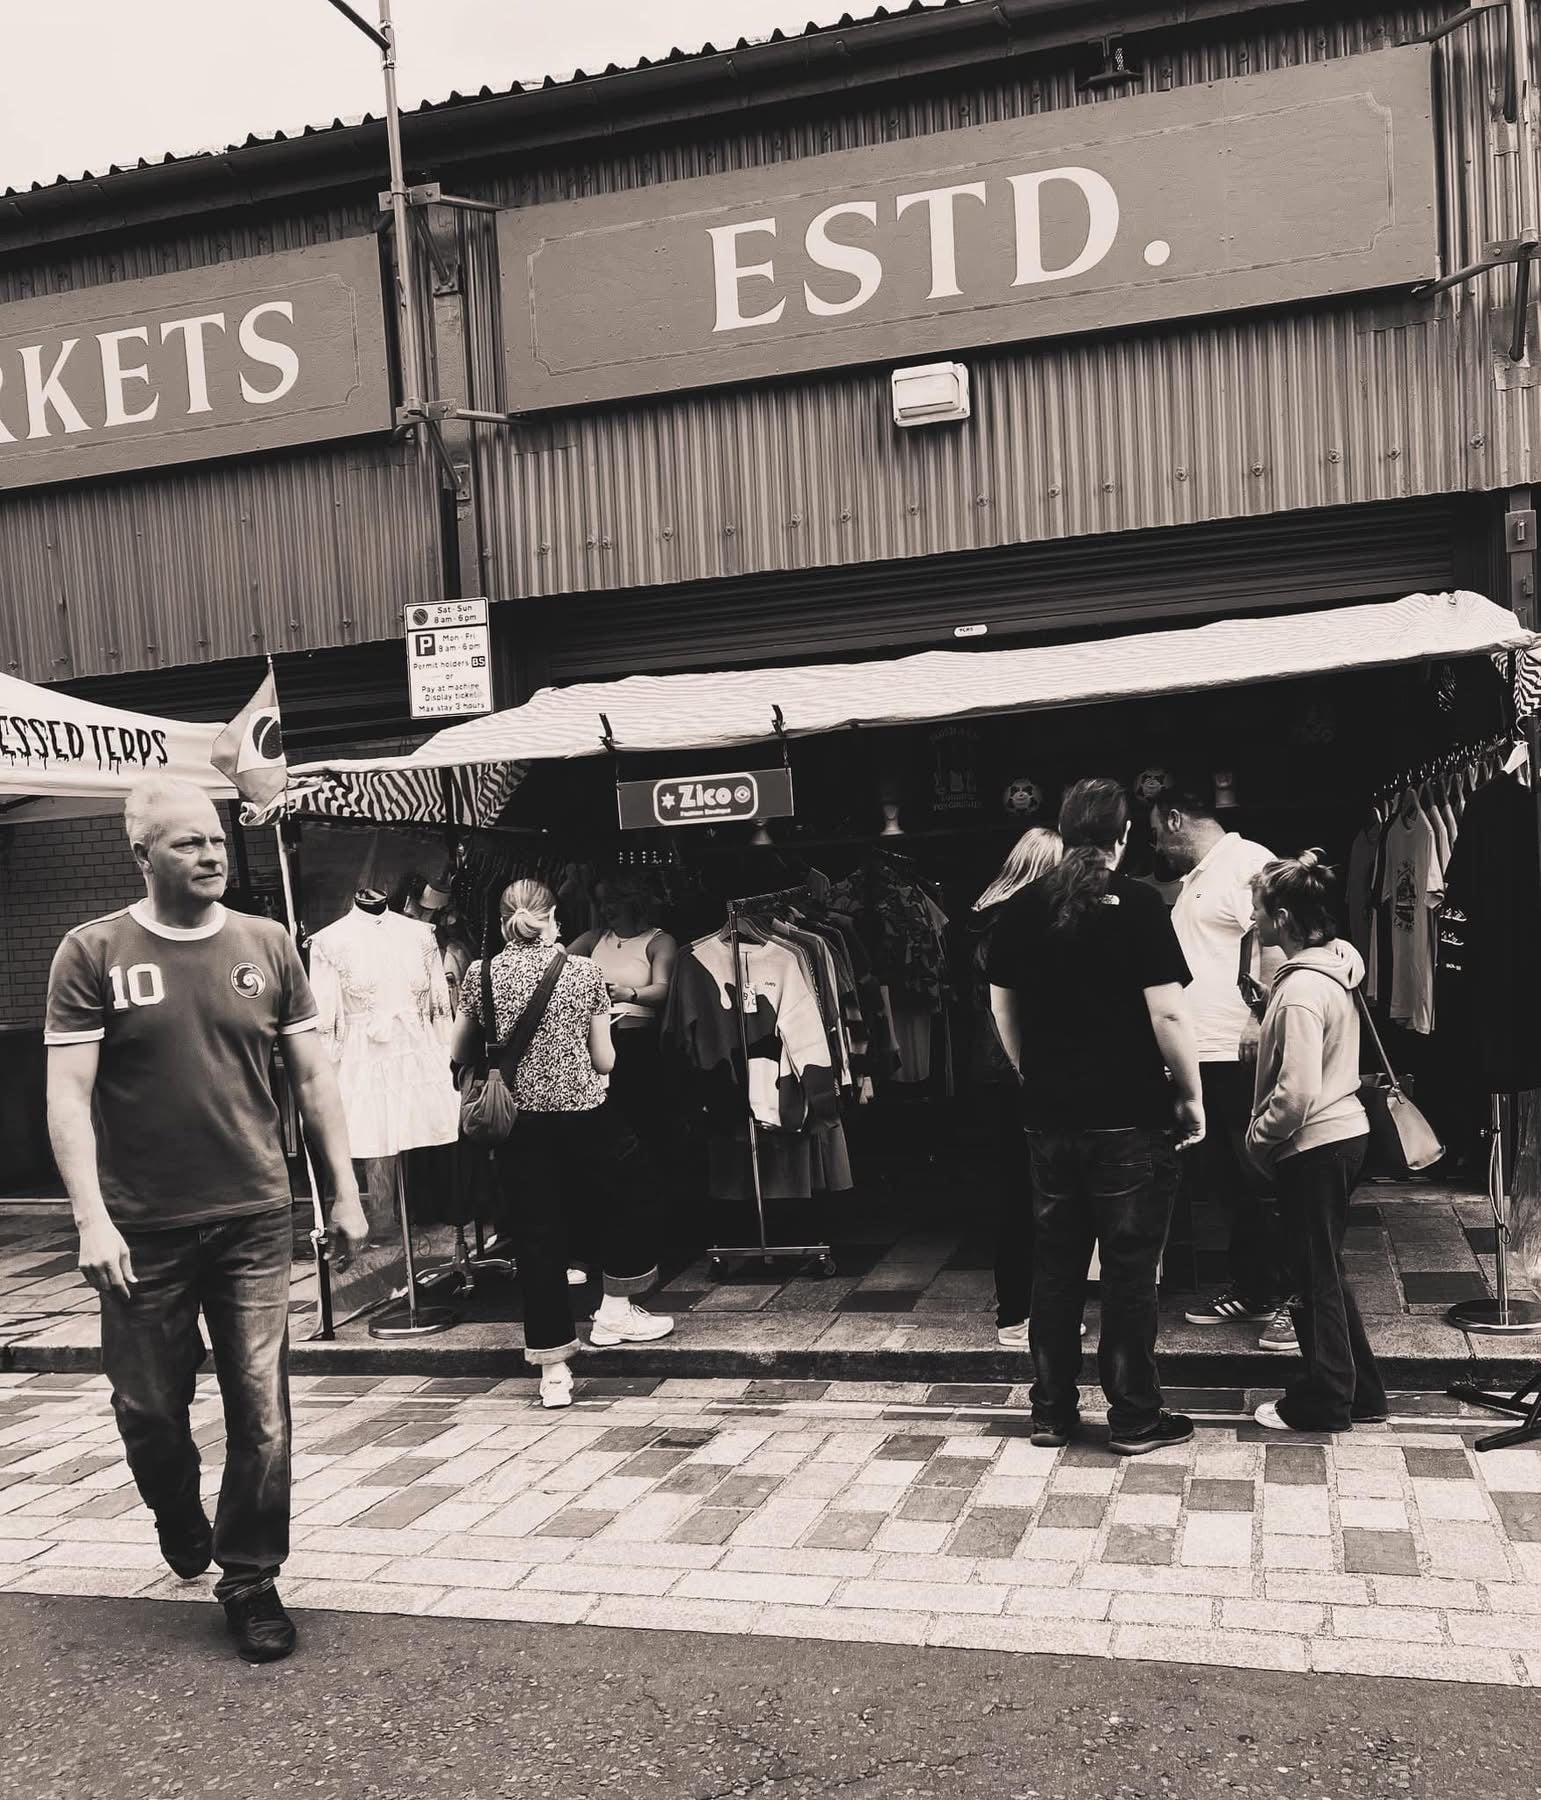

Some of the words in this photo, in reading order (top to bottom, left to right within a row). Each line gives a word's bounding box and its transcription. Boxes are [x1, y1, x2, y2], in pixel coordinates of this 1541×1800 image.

[705, 166, 1171, 333] ESTD.
[437, 606, 451, 614] Sat
[442, 634, 459, 642] Mon
[419, 636, 432, 655] P
[413, 662, 438, 670] Permit
[440, 660, 469, 668] holders
[421, 685, 435, 693] Pay
[448, 683, 480, 691] machine
[425, 693, 452, 702] Display
[419, 705, 434, 713] Max
[437, 704, 452, 712] stay
[462, 702, 484, 710] hours
[86, 724, 168, 775] TERPS
[678, 784, 732, 808] Zico
[109, 963, 165, 1010] 10
